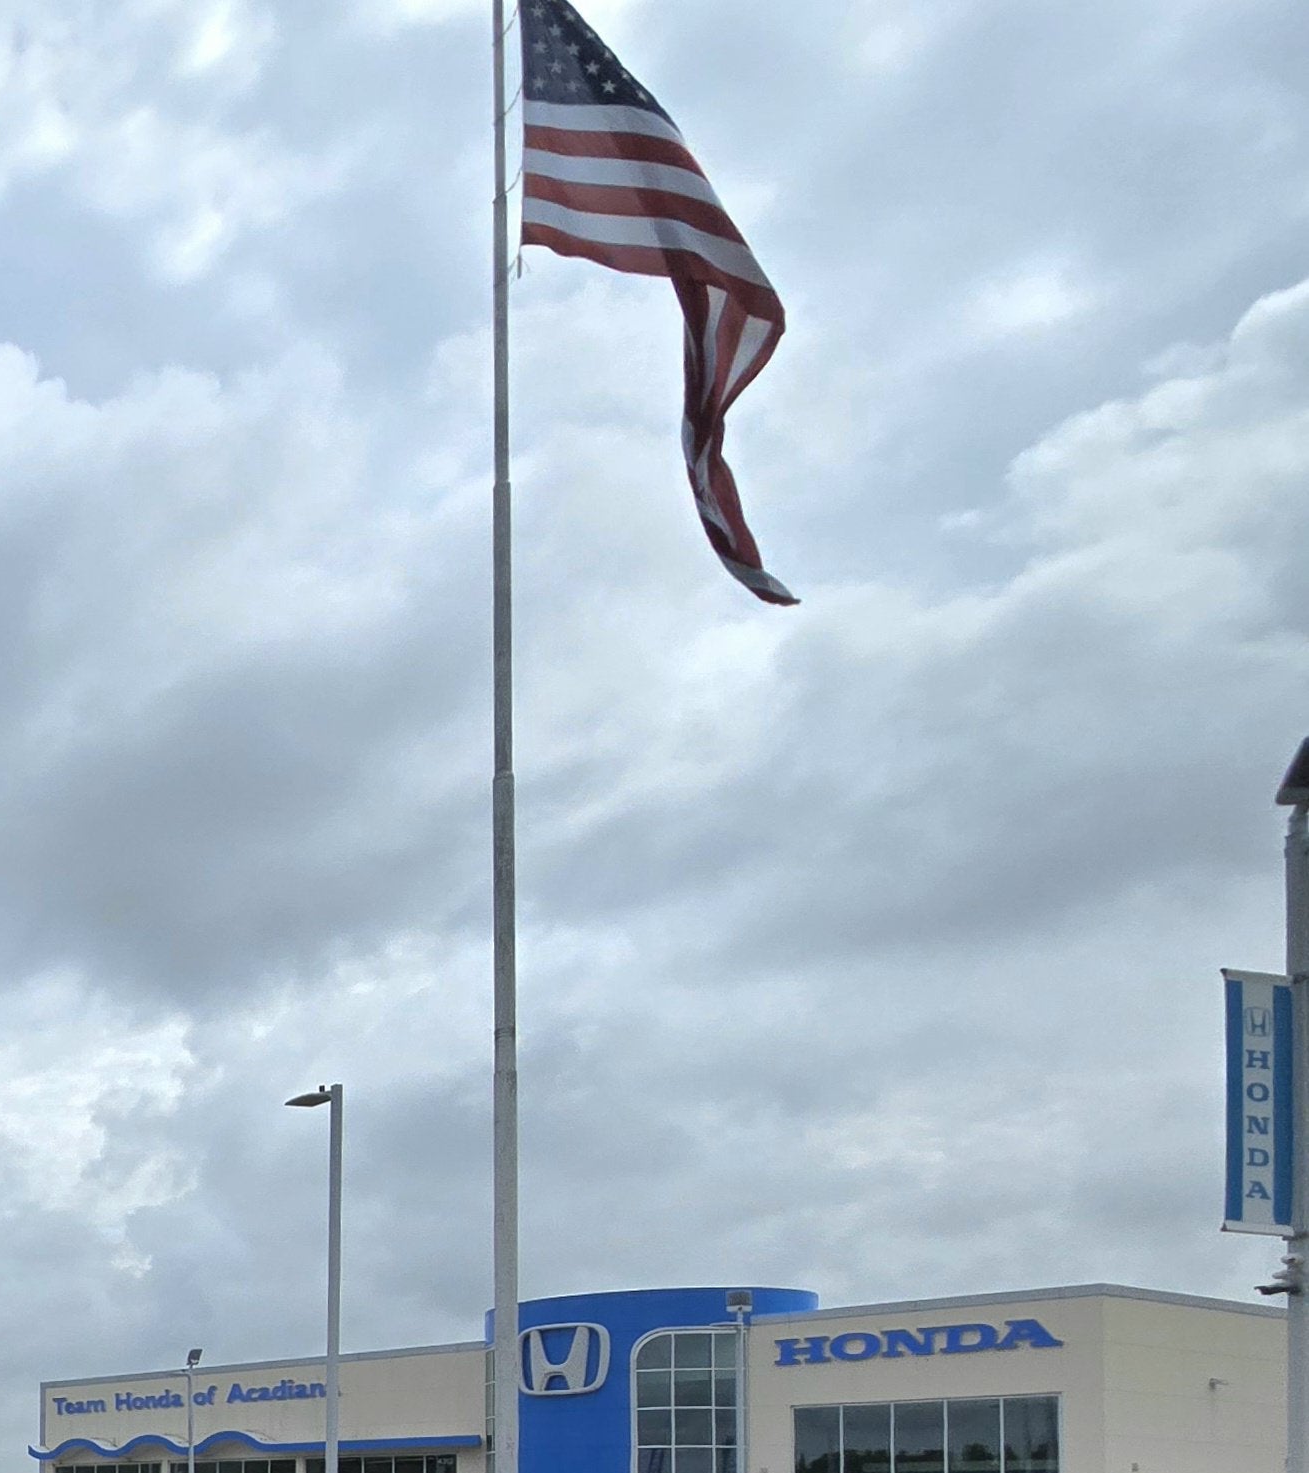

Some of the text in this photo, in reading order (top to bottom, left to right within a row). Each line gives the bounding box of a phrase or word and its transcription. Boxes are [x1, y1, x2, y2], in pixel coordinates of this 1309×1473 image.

[1245, 1049, 1271, 1200] HONDA
[774, 1318, 1064, 1366] HONDA
[53, 1379, 340, 1415] Team Honda of Acadian
